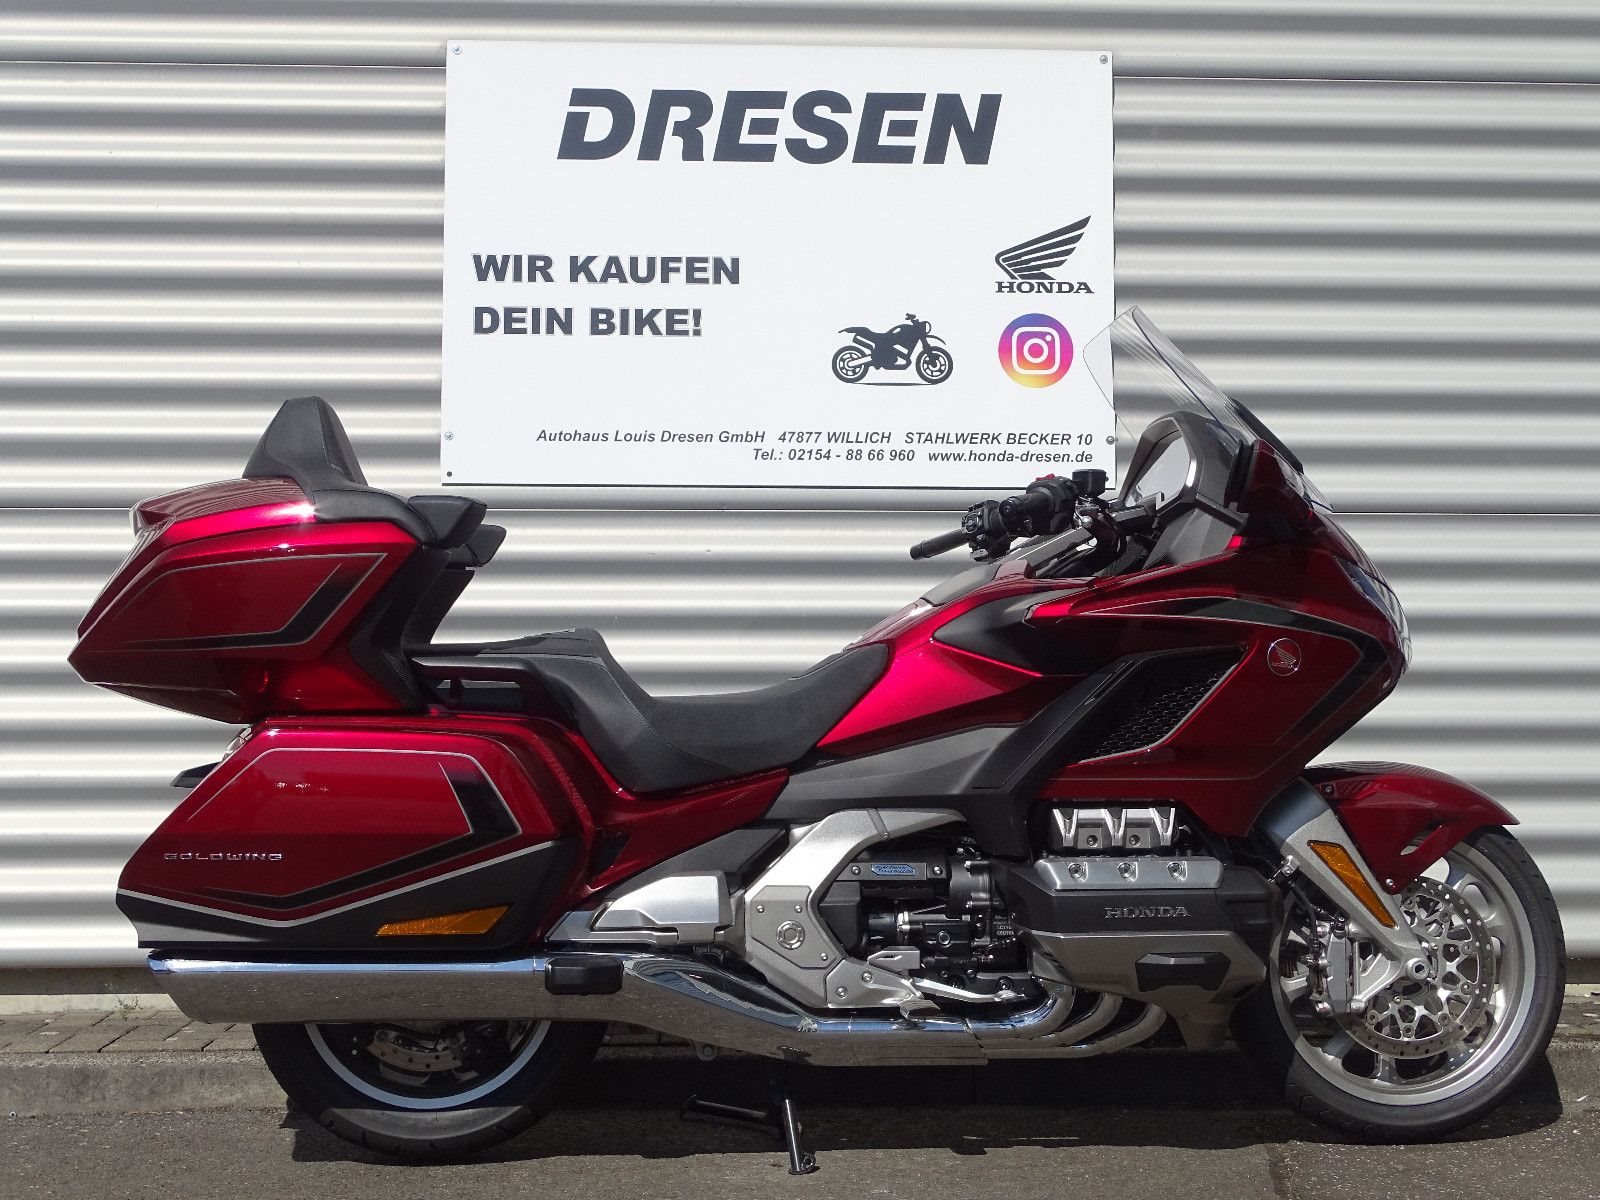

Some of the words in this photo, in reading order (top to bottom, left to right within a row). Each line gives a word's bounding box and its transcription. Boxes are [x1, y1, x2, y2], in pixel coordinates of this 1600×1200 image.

[557, 87, 1003, 165] DRESEN
[472, 254, 555, 283] WIR
[569, 255, 741, 285] KAUFEN
[995, 281, 1094, 294] HONDA
[473, 306, 573, 335] DEIN
[590, 307, 702, 337] BIKE!
[536, 429, 610, 442] Autohaus
[614, 429, 656, 443] Louis
[660, 430, 714, 443] Dresen
[718, 430, 766, 443] GmbH
[778, 431, 823, 444] 47877
[827, 431, 892, 444] WILLICH
[904, 432, 1003, 445] STAHLWERK
[1006, 432, 1072, 446] BECKER
[1076, 433, 1093, 446] 10
[753, 448, 784, 461] Tel.:
[787, 448, 832, 461] 02154
[845, 448, 863, 461] 88
[867, 449, 885, 462] 66
[888, 449, 916, 462] 960
[928, 449, 1093, 463] www.honda-dresen.de
[1104, 906, 1191, 918] HONDA
